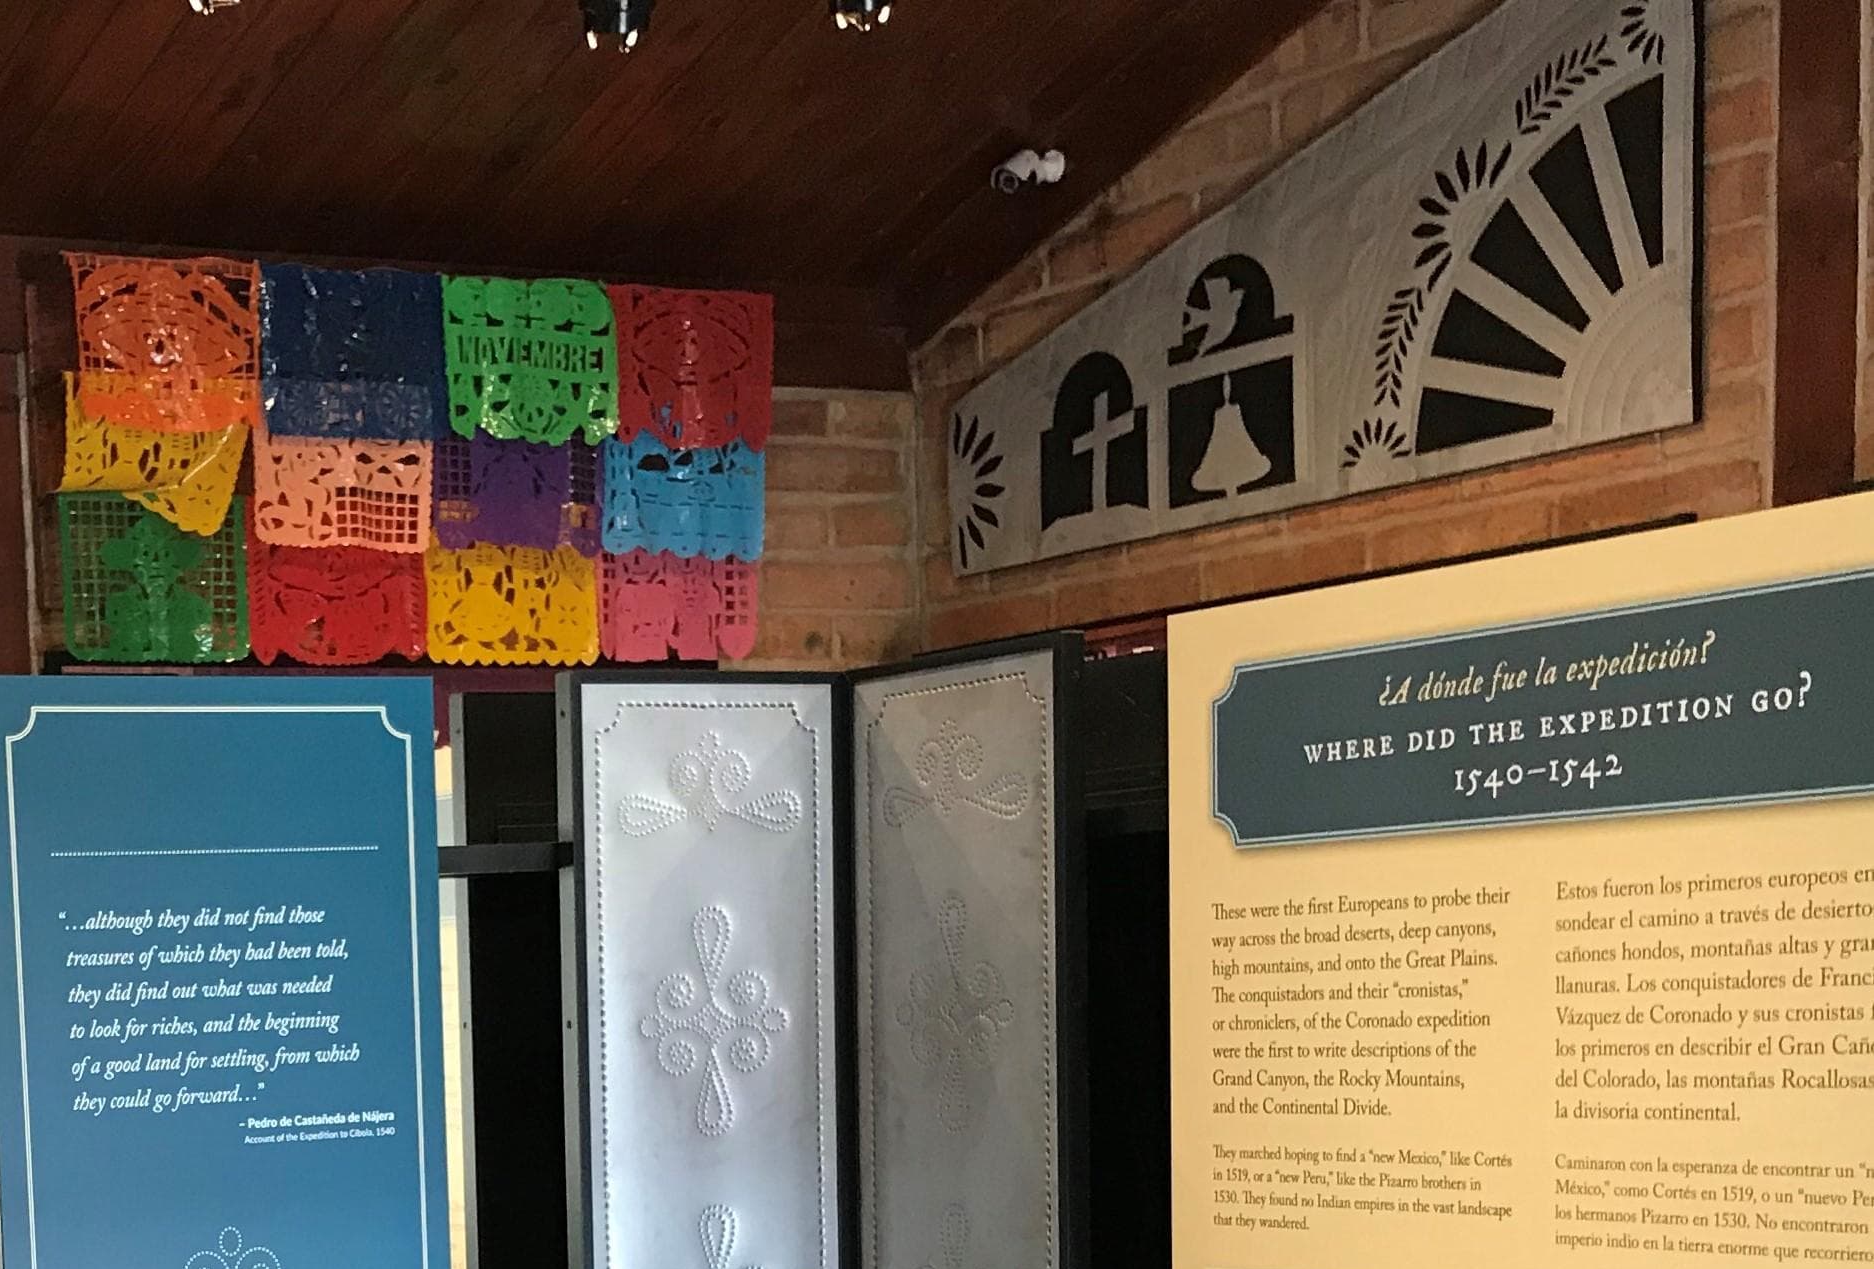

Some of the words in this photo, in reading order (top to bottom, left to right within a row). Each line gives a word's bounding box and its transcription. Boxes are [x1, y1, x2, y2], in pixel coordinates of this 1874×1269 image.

[457, 334, 604, 373] NOVIEMBRE
[1417, 661, 1485, 702] dónde
[1485, 660, 1529, 702] fue
[1534, 656, 1557, 687] la
[1564, 629, 1717, 691] expedición?
[1303, 735, 1395, 764] WHERE
[1407, 727, 1456, 753] DID
[1468, 719, 1525, 745] THE
[1539, 694, 1734, 738] EXPEDITION
[1751, 672, 1812, 713] GO?
[1556, 880, 1598, 901] Estos
[1603, 878, 1655, 898] fueron
[1659, 874, 1683, 895] los
[1687, 873, 1763, 900] primeros
[1767, 870, 1848, 893] europeos
[157, 908, 192, 934] they
[193, 907, 222, 928] did
[223, 909, 249, 927] not
[247, 905, 285, 932] find
[287, 904, 327, 926] those
[1211, 902, 1247, 921] These
[1250, 905, 1280, 918] were
[1283, 898, 1304, 917] the
[1307, 896, 1334, 916] first
[1338, 895, 1410, 918] Europeans
[1413, 895, 1428, 909] to
[1431, 887, 1472, 914] probe
[1475, 886, 1511, 906] their
[244, 1134, 276, 1144] Account
[275, 1133, 285, 1143] of
[285, 1132, 299, 1142] the
[299, 1129, 339, 1142] Expedition
[376, 1126, 396, 1137] 1540
[247, 1116, 278, 1129] Pedro
[279, 1115, 293, 1128] de
[293, 1112, 347, 1127] Castañeda
[347, 1111, 361, 1124] de
[362, 1110, 395, 1124] Nájera
